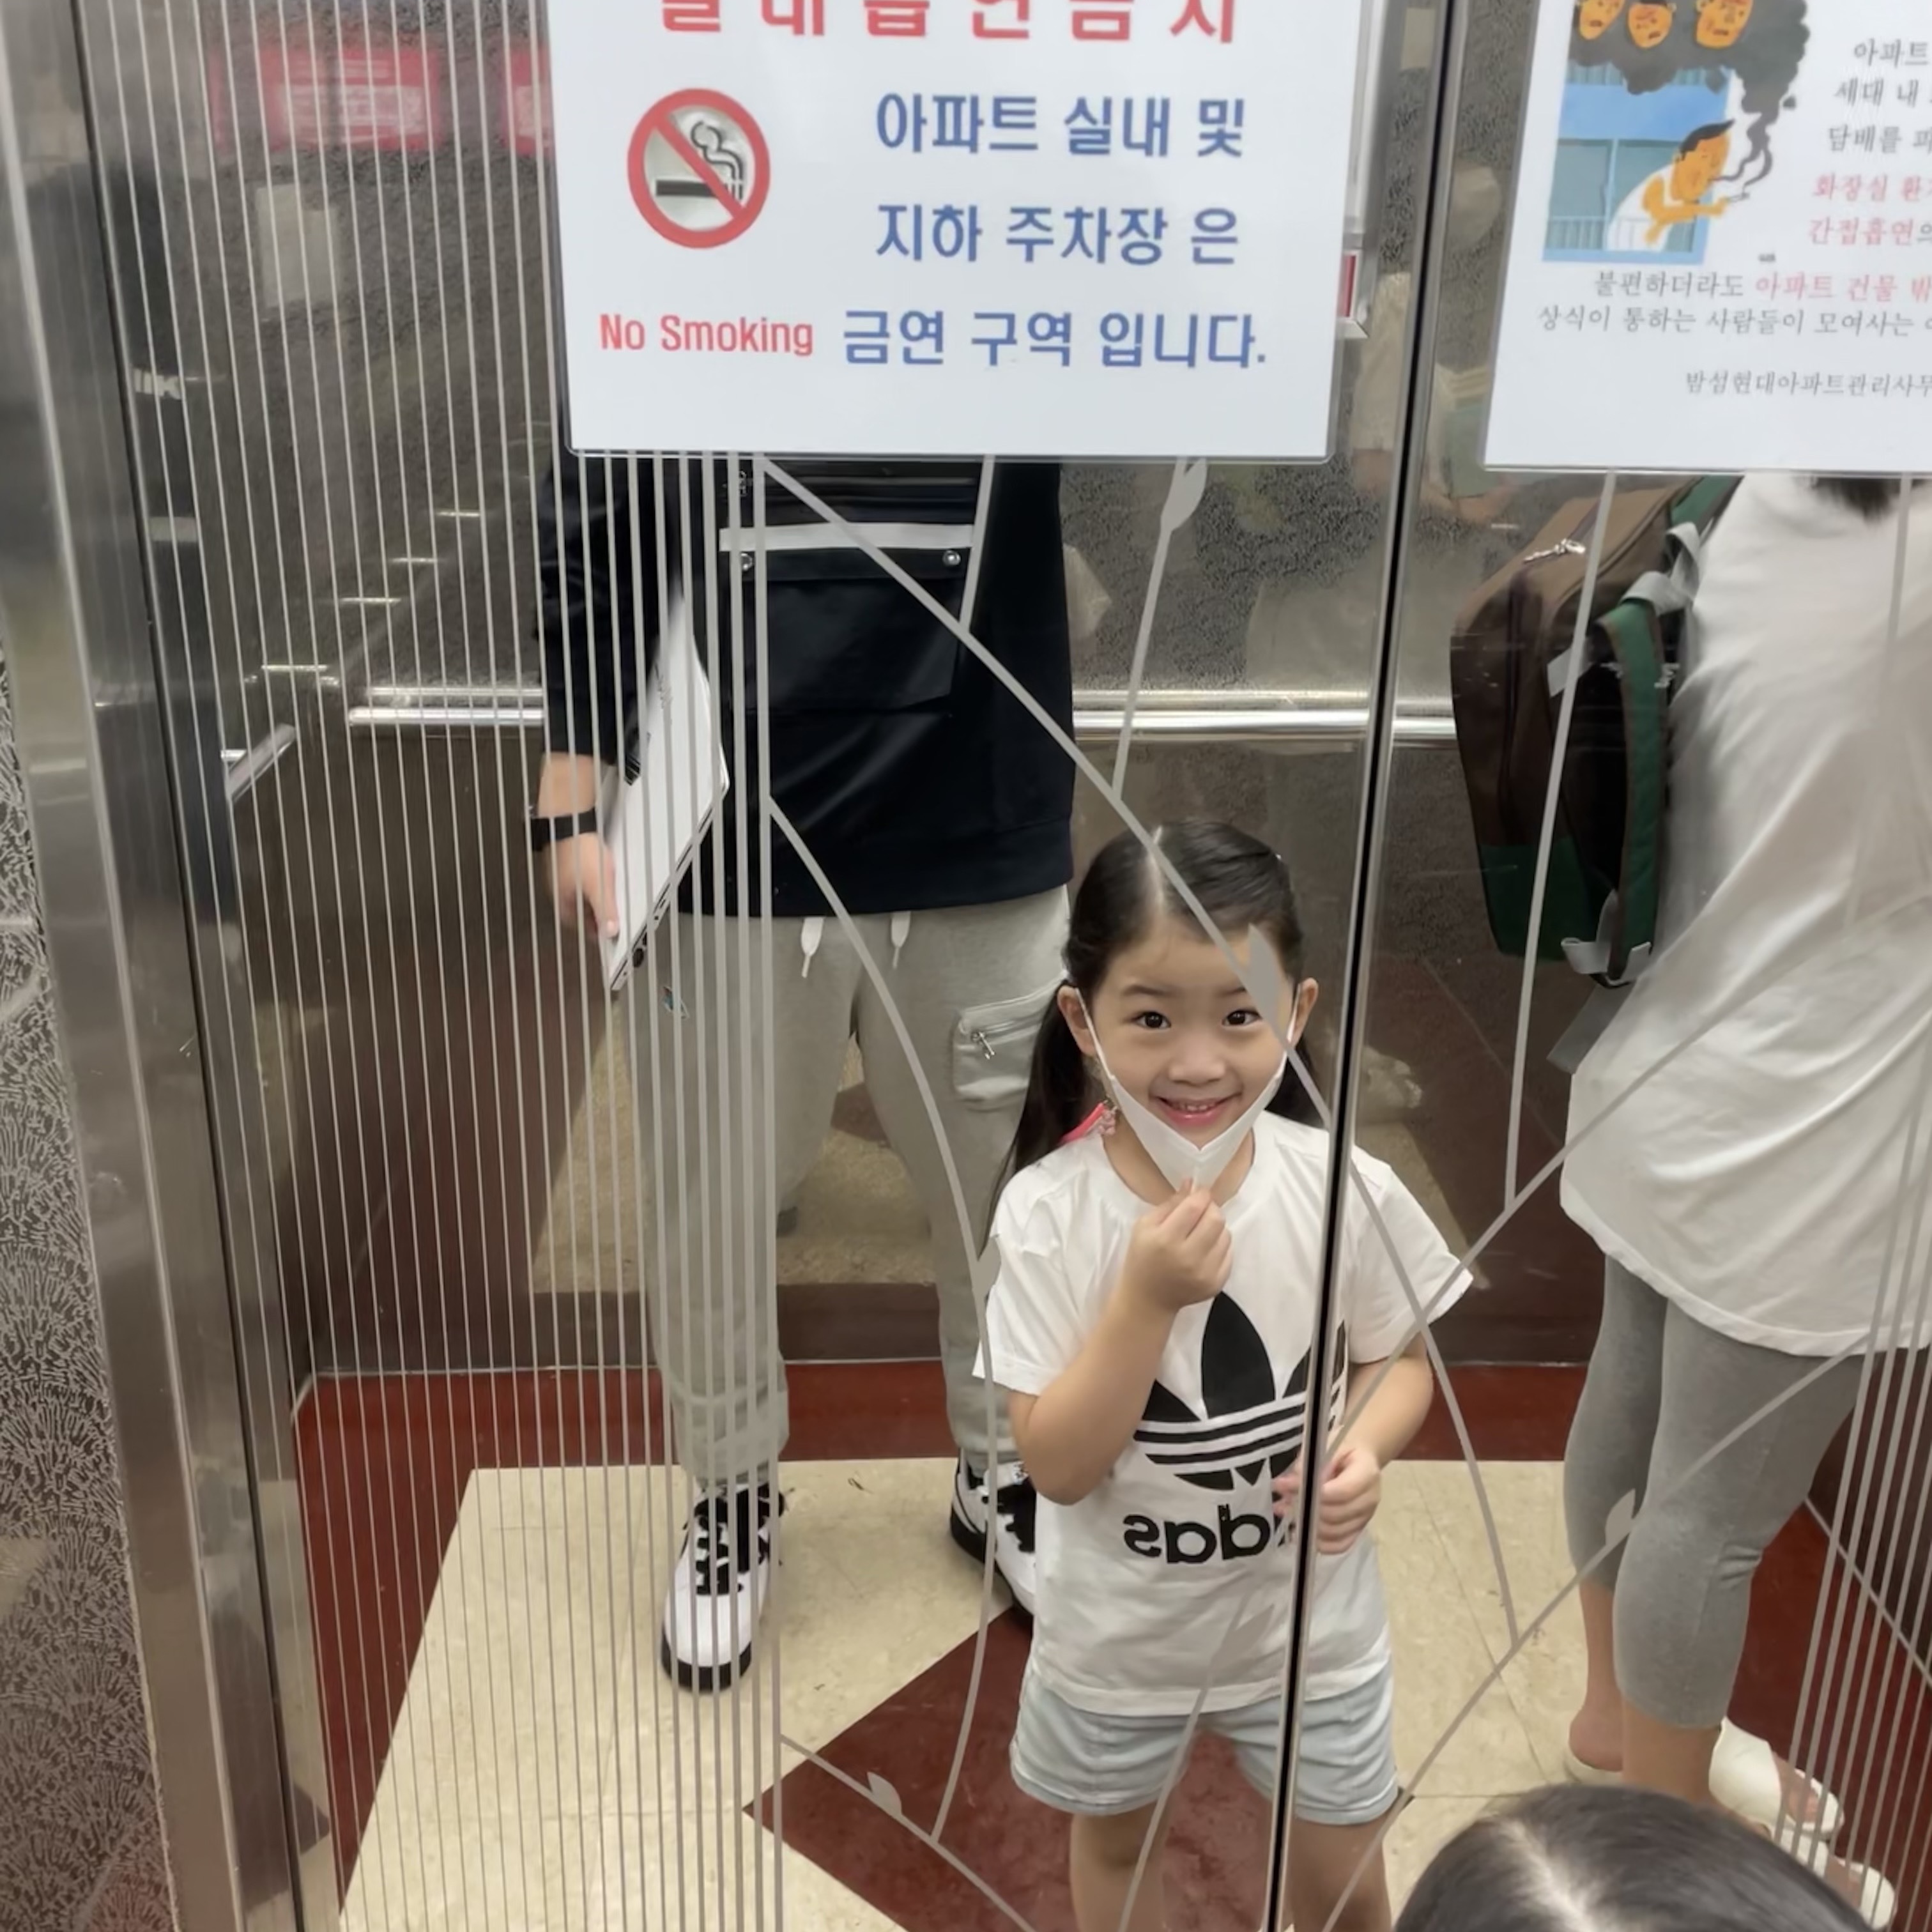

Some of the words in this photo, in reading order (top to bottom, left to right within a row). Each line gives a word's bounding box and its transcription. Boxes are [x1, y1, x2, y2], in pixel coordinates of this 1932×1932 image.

[1853, 38, 1929, 68] 아파트
[1834, 77, 1884, 107] 세대
[1896, 79, 1919, 108] 내
[877, 93, 1038, 154] 아파트
[1064, 96, 1170, 157] 실내
[1197, 98, 1245, 158] 및
[1827, 124, 1902, 155] 담배를
[1813, 172, 1887, 202] 화장실
[876, 203, 983, 263] 지하
[1006, 206, 1169, 266] 주차장
[1190, 207, 1238, 264] 은
[1595, 270, 1743, 298] 불편하더라도
[1756, 272, 1833, 300] 아파트
[1848, 274, 1897, 302] 건물
[599, 313, 645, 351] No
[661, 314, 813, 357] Smoking
[1540, 304, 1611, 332] 상식이
[1623, 307, 1696, 333] 통하는
[1707, 307, 1804, 335] 사람들이
[1814, 310, 1914, 337] 모여사는
[843, 310, 944, 365] 금연
[970, 311, 1072, 367] 구역
[1100, 312, 1266, 369] 입니다.
